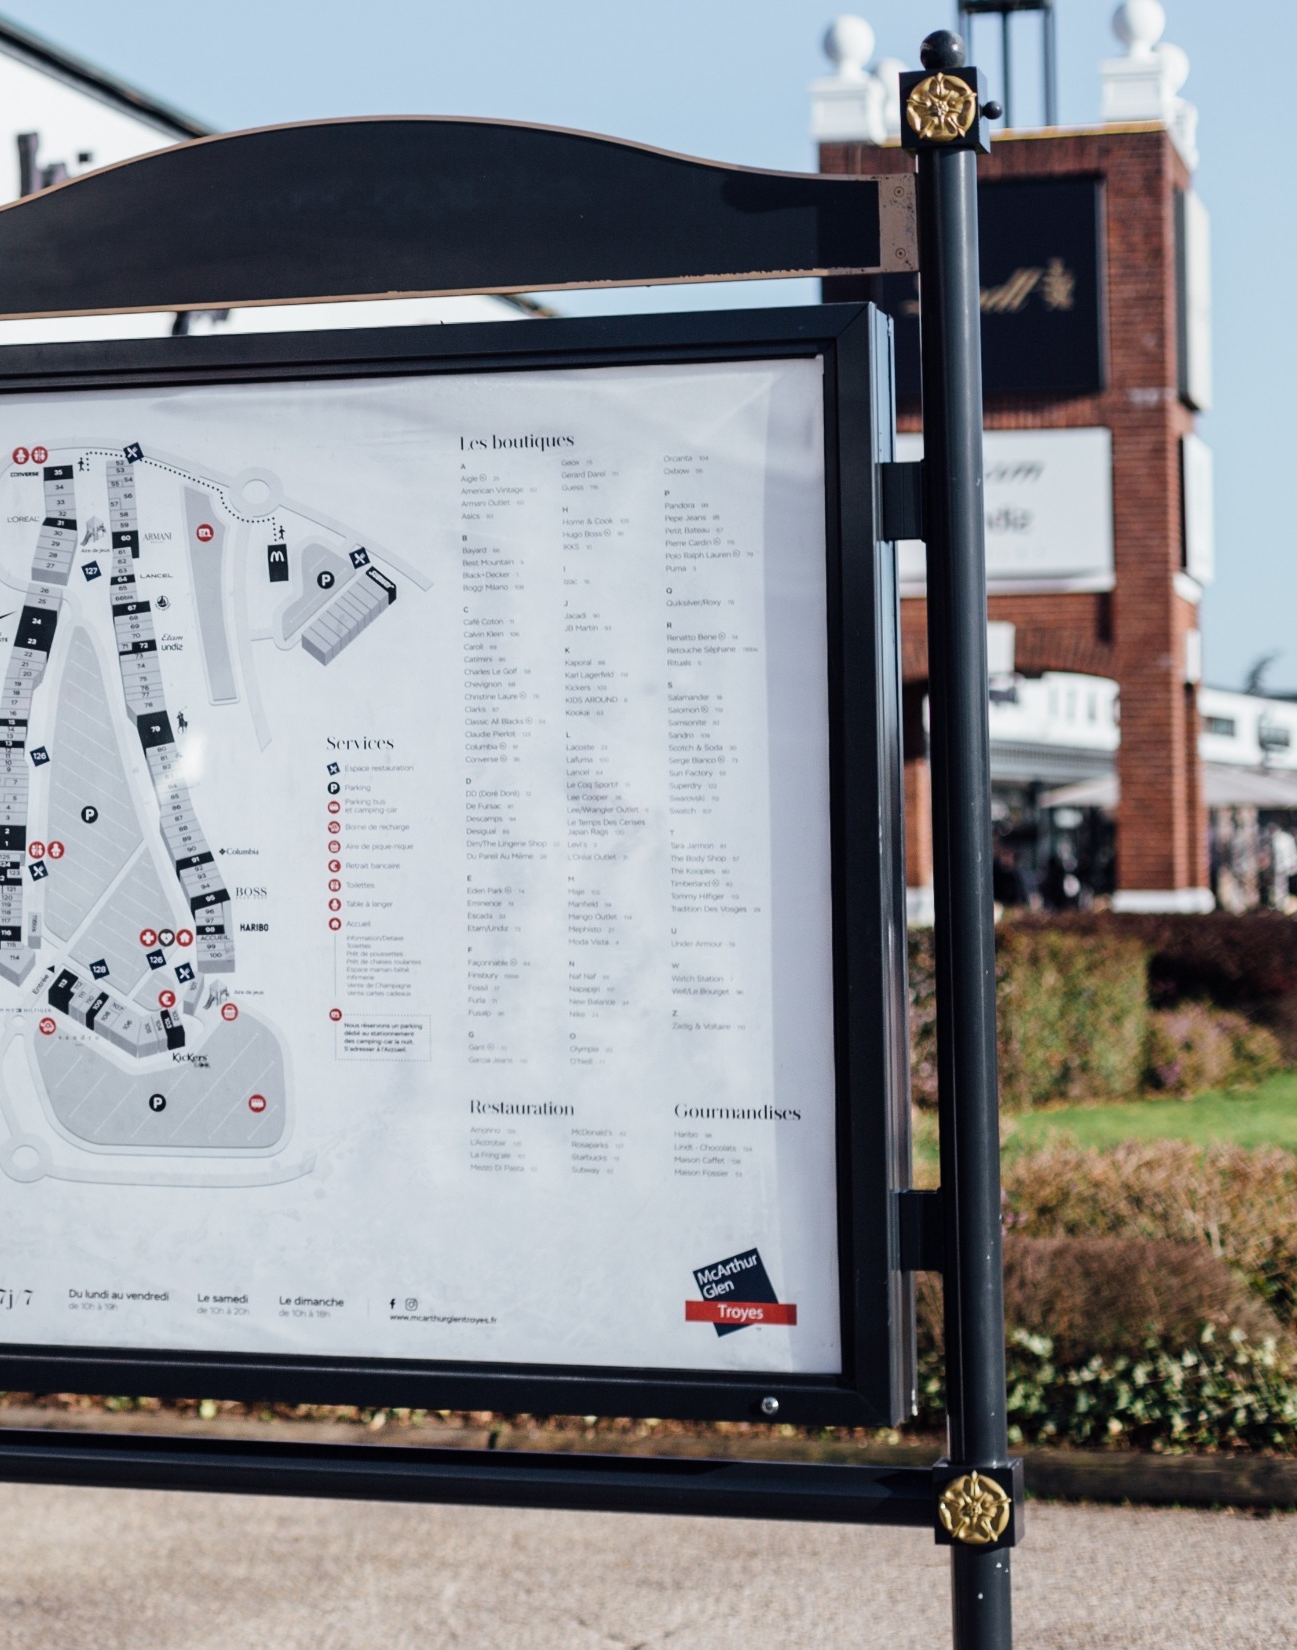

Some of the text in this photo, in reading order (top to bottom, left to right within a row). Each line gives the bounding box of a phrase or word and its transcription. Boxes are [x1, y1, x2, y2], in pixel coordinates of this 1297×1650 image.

[460, 434, 575, 452] Les boutiques
[143, 532, 172, 541] ARMANI
[85, 567, 98, 575] 127
[326, 736, 394, 750] Services
[33, 752, 47, 760] 126
[235, 887, 267, 896] BOSS
[240, 923, 268, 932] HARIBO
[150, 956, 163, 964] 126
[470, 1099, 575, 1116] Restauration
[674, 1103, 802, 1121] Gourmandises
[697, 1254, 758, 1286] McArthur
[69, 1289, 169, 1302] Du lundi au vendredi
[703, 1280, 735, 1299] Glen
[197, 1293, 249, 1304] Le samedi
[279, 1296, 344, 1308] Le dimanche
[717, 1304, 763, 1322] Troyes
